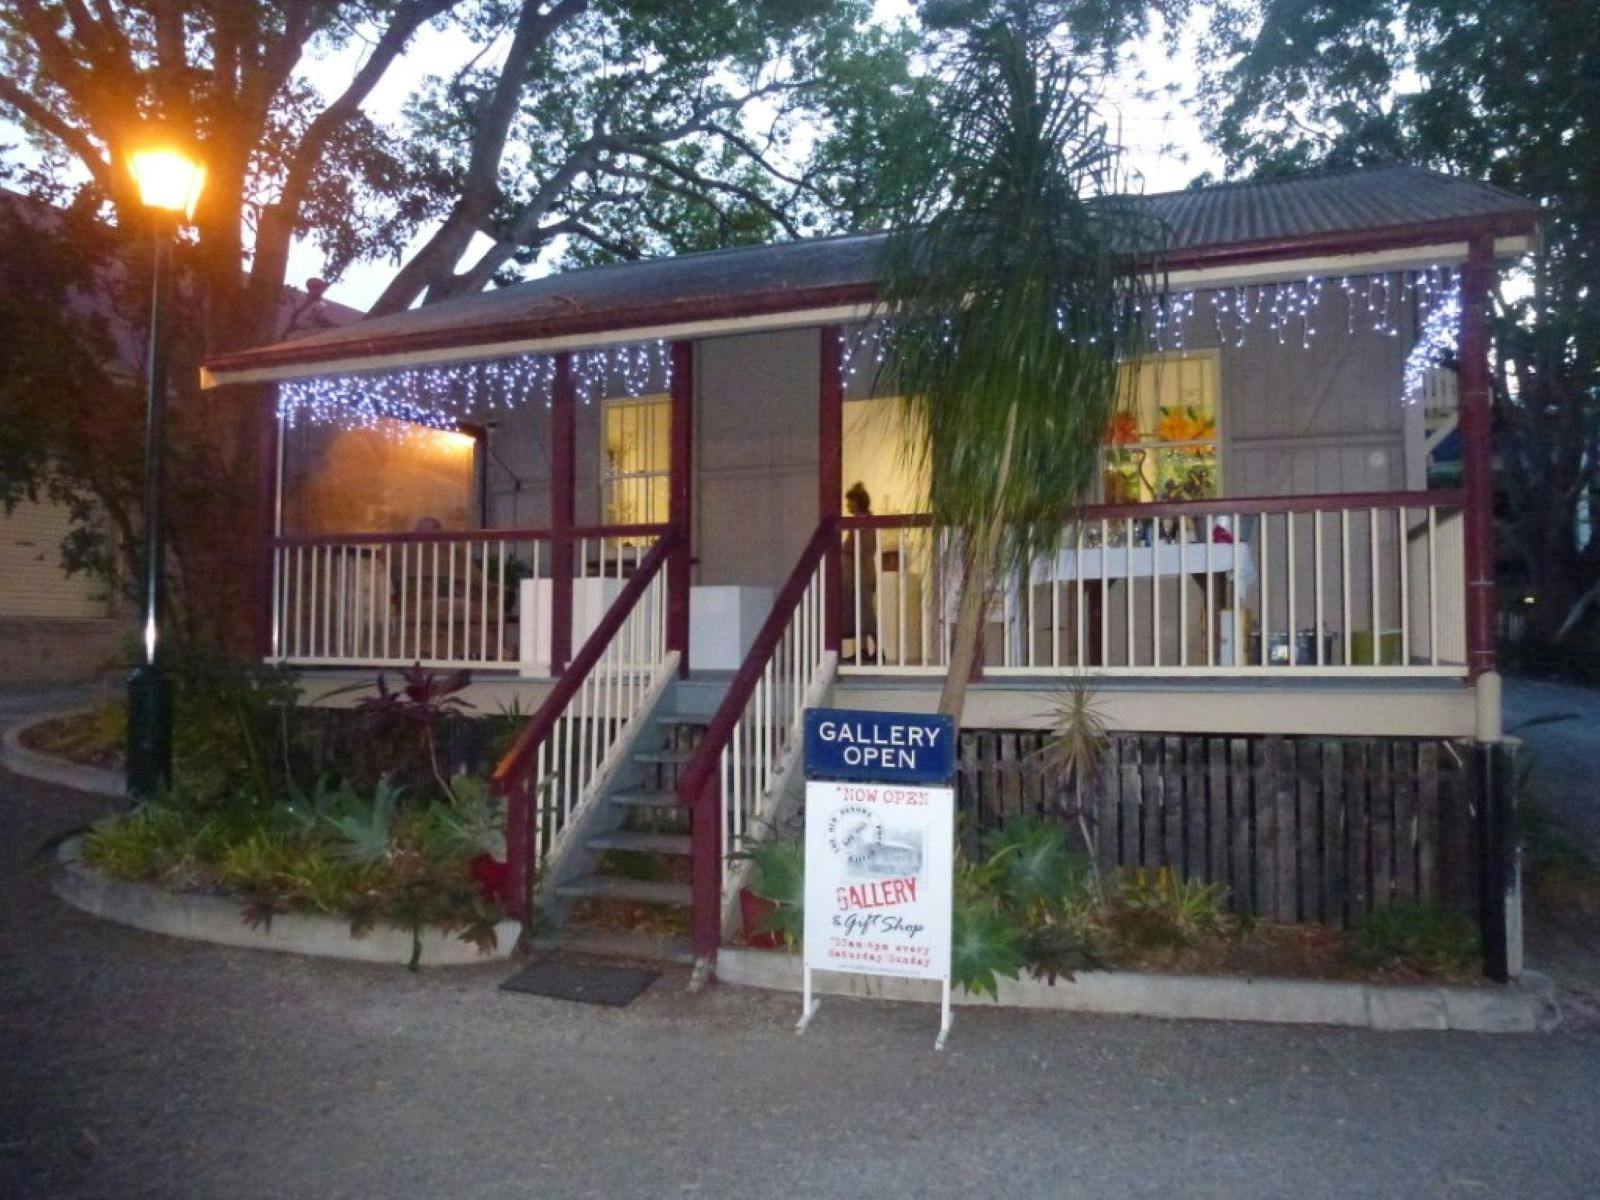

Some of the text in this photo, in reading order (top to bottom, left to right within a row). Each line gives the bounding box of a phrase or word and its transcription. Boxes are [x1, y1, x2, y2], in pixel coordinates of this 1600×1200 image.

[819, 721, 940, 747] GALLERY
[843, 746, 916, 769] OPEN
[883, 789, 929, 806] OPEN
[836, 876, 917, 911] GALLERY
[844, 913, 882, 936] Gift
[881, 916, 925, 938] Shop
